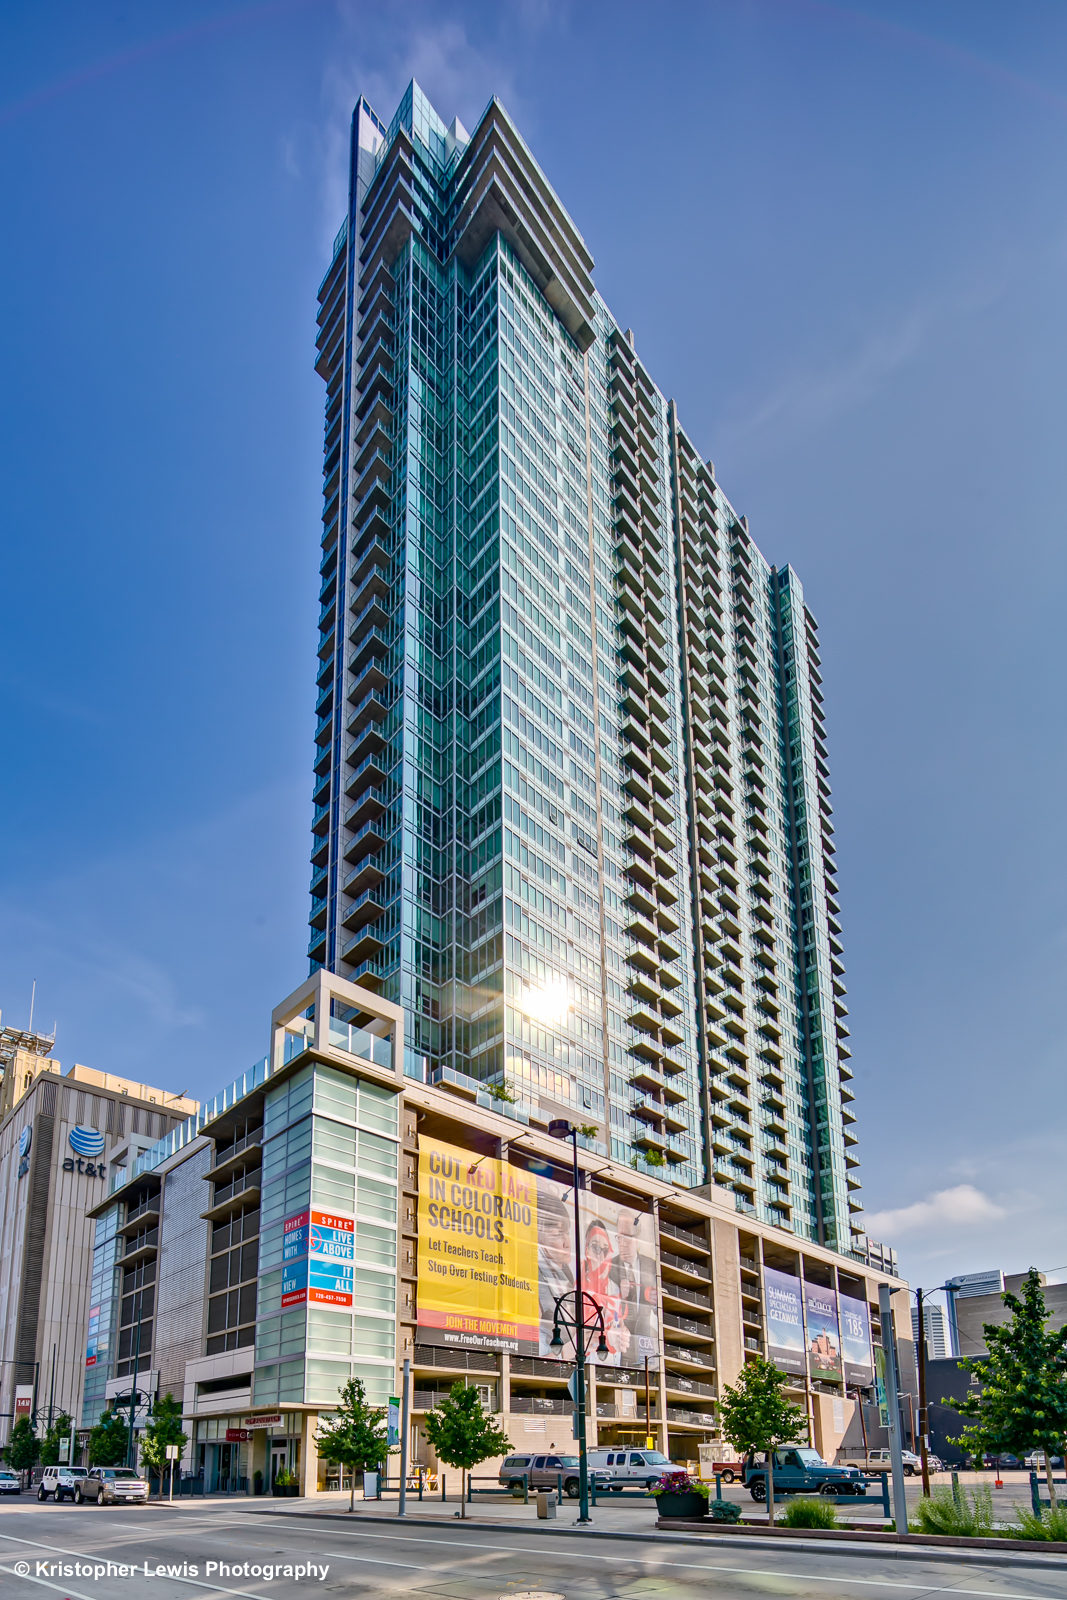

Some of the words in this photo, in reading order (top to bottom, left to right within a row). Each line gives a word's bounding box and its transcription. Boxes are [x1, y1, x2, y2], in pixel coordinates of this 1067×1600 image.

[62, 1157, 107, 1181] at&t
[429, 1150, 462, 1181] CUT
[466, 1162, 495, 1191] RED
[500, 1171, 531, 1203] TAPE
[428, 1177, 446, 1203] IN
[451, 1184, 532, 1226] COLORADO
[428, 1203, 508, 1244] SCHOOLS.
[284, 1230, 302, 1246] HOMES
[332, 1230, 352, 1245] LIVE
[284, 1245, 298, 1259] WITH
[322, 1242, 352, 1258] ABOVE
[428, 1237, 442, 1251] Let
[443, 1241, 478, 1260] Teachers
[480, 1249, 506, 1265] Teach.
[284, 1268, 288, 1279] A
[342, 1266, 351, 1278] IT
[428, 1260, 448, 1276] Stop
[449, 1264, 468, 1278] Over
[470, 1268, 498, 1286] Testing
[500, 1274, 532, 1292] Students.
[283, 1278, 296, 1292] VIEW
[335, 1278, 351, 1292] ALL
[768, 1286, 797, 1305] SUMMER
[769, 1300, 798, 1313] SPECTACULAR
[770, 1309, 798, 1324] GETAWAY
[446, 1315, 462, 1329] JOIN
[464, 1318, 478, 1331] THE
[479, 1321, 518, 1337] MOVEMENT
[444, 1332, 519, 1350] www.FreeOurTeachers.org
[638, 1338, 654, 1349] CFA
